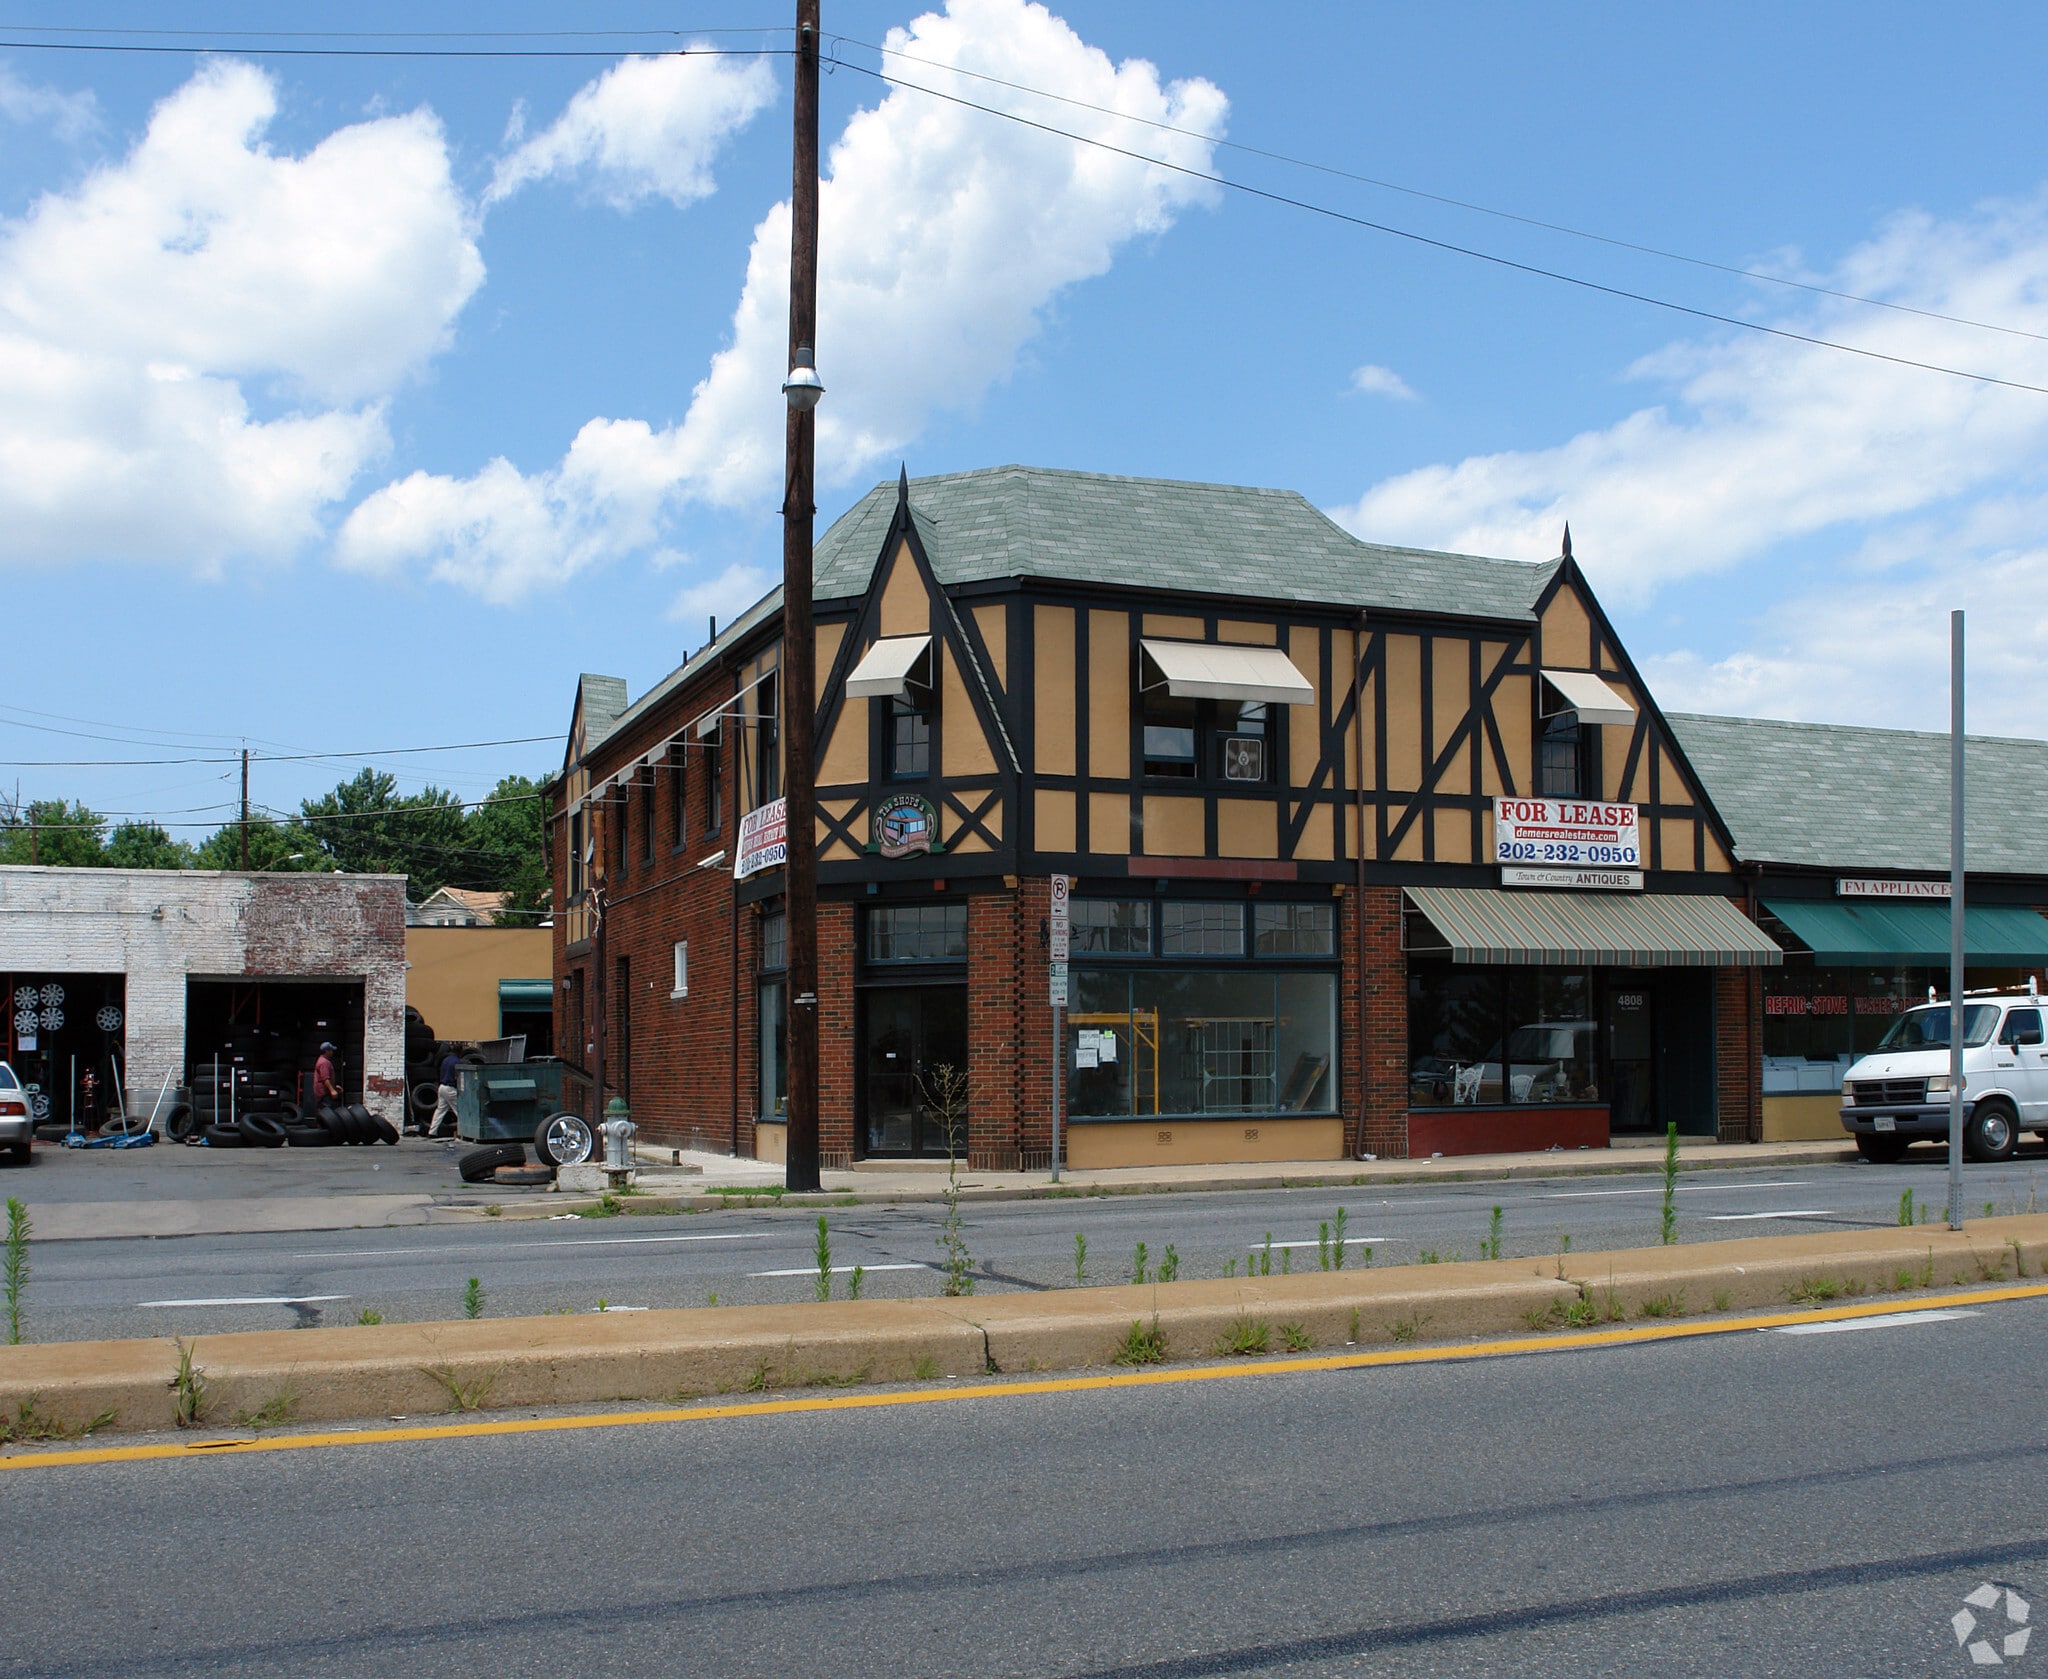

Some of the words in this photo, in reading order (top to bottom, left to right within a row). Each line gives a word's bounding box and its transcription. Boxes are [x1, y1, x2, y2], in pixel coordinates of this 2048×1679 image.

[893, 796, 920, 807] SHOPS
[1500, 801, 1548, 822] FOR
[1558, 804, 1634, 826] LEASE
[1516, 827, 1617, 842] demersrealestate.com
[1499, 842, 1636, 863] 202-232-0950
[1516, 872, 1536, 882] Town
[1546, 872, 1573, 885] Country
[1576, 873, 1630, 885] ANTIQUES
[1844, 881, 1866, 893] FM
[1870, 882, 1952, 896] APPLIANCE
[1617, 994, 1643, 1006] 4808
[1765, 995, 1806, 1015] REFRIG
[1812, 995, 1848, 1015] STOVE
[1854, 997, 1894, 1015] WASHER
